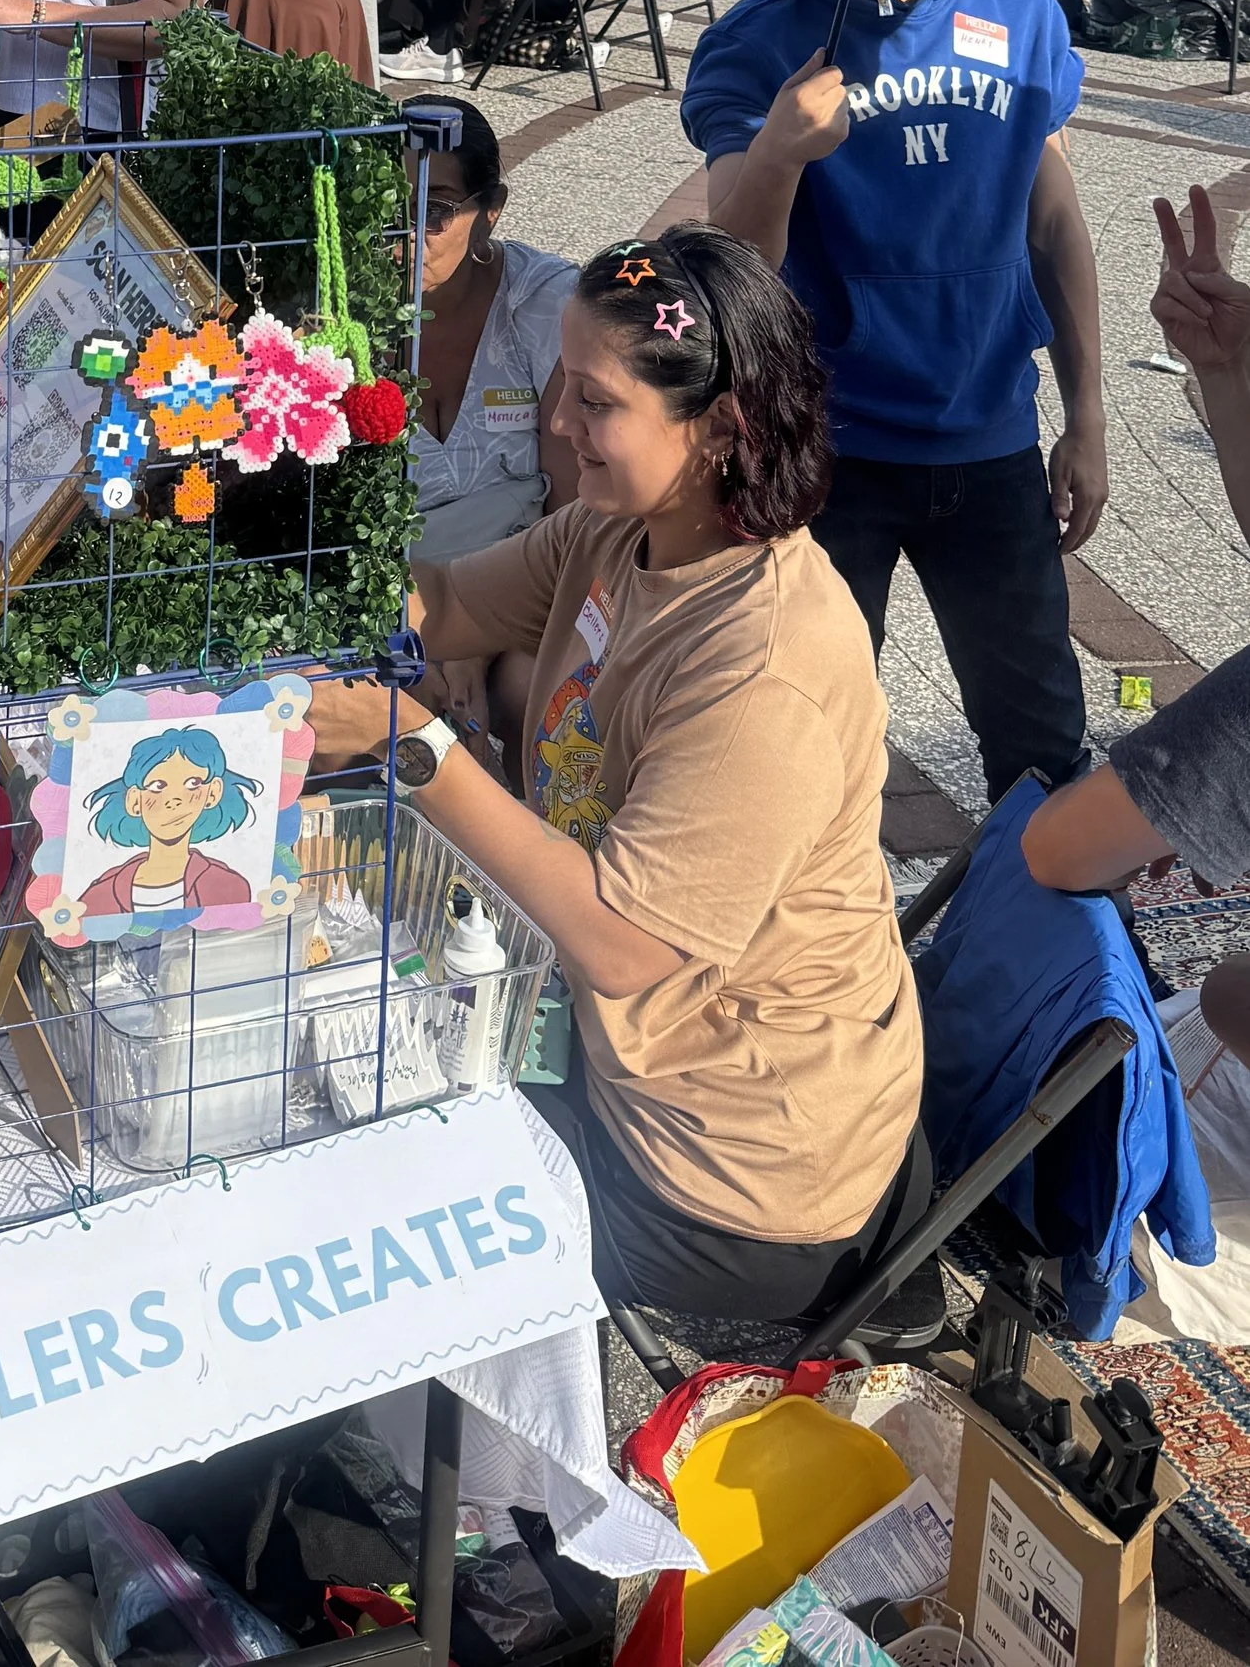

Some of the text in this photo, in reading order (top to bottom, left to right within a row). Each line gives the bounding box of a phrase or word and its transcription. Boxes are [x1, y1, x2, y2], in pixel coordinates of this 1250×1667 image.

[846, 65, 1014, 122] ROOKLYN
[902, 122, 950, 166] NY
[119, 282, 168, 337] HER
[496, 389, 532, 400] HELLO
[109, 488, 123, 505] 12
[217, 1185, 547, 1343] CREATES
[988, 1547, 1013, 1582] 015
[1018, 1580, 1030, 1602] C
[985, 1620, 1007, 1650] EWR
[1038, 1599, 1070, 1642] JFK
